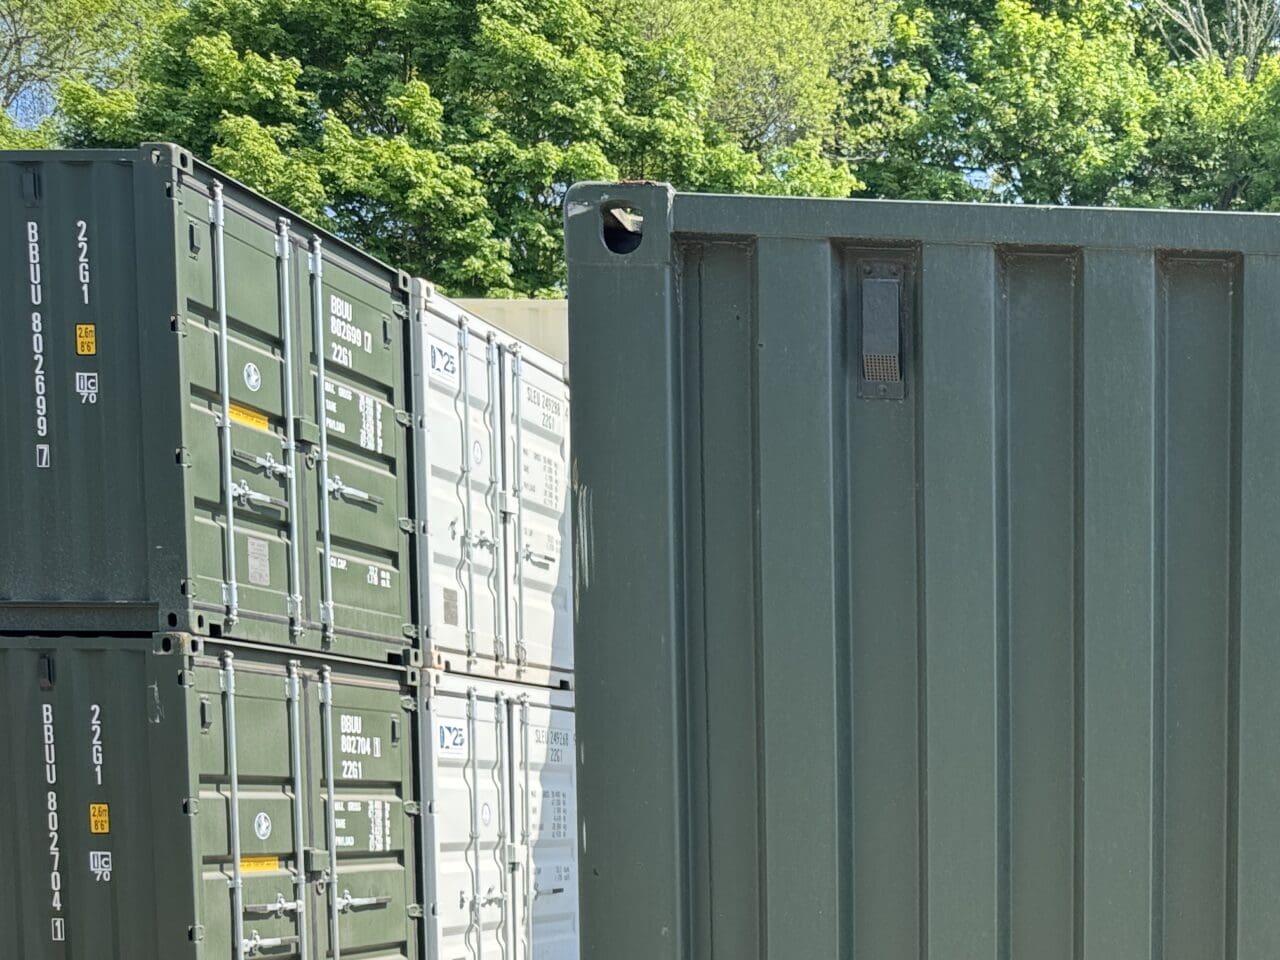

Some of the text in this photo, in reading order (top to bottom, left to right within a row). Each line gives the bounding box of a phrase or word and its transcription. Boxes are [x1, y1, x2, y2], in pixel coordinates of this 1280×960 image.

[76, 220, 90, 304] 22G1
[330, 294, 352, 322] BBUU
[27, 221, 48, 466] BBUU 802699 7
[330, 315, 362, 347] 802699
[80, 392, 97, 404] 70
[91, 704, 103, 785] 22G1
[341, 734, 371, 756] 802704
[42, 704, 62, 939] BBUU 802704 1
[94, 870, 111, 882] 70
